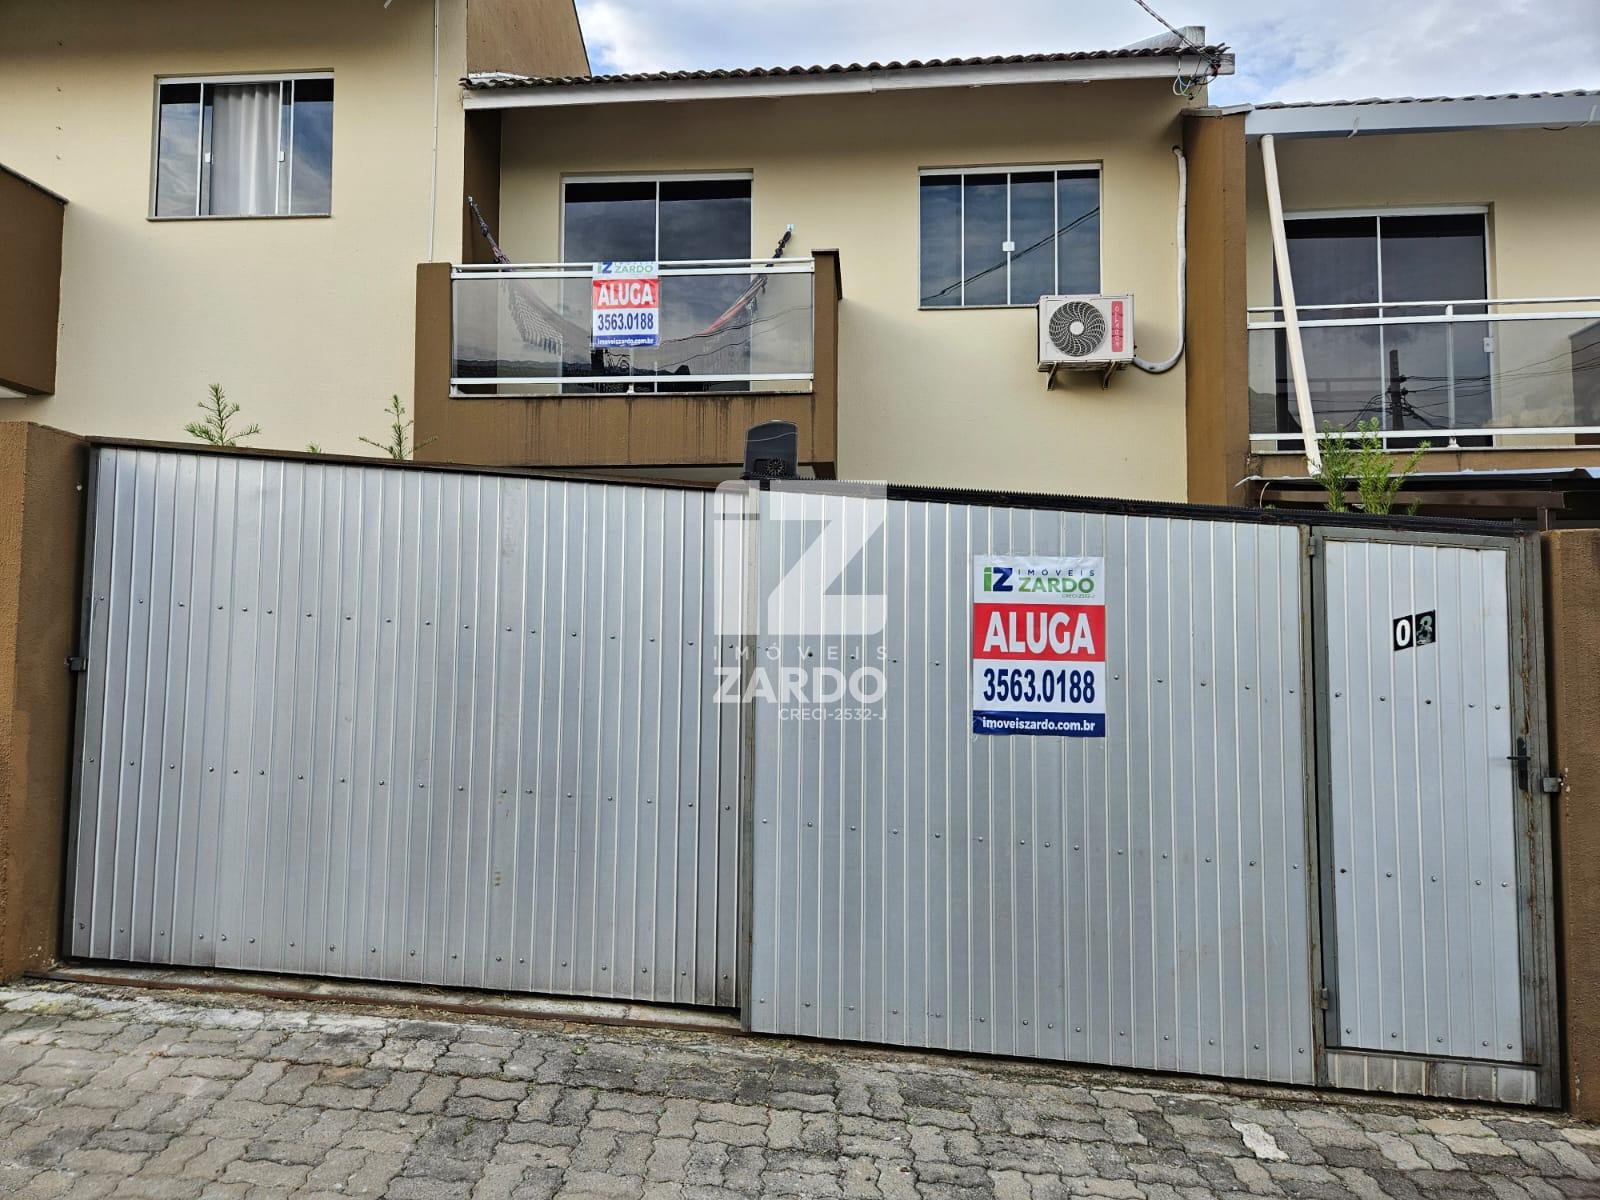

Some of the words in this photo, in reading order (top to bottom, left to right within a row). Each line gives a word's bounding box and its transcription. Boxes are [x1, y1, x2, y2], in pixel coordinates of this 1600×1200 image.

[615, 264, 654, 274] ZARDO
[597, 282, 654, 306] ALUGA
[598, 312, 654, 331] 3563.0188
[983, 567, 1013, 592] iZ
[1018, 569, 1095, 577] IMÓVEIS
[1018, 577, 1095, 593] ZARDO
[983, 611, 1096, 654] ALUGA
[983, 668, 1095, 703] 3563.0188
[982, 716, 1096, 731] imoveiszardo.com.br
